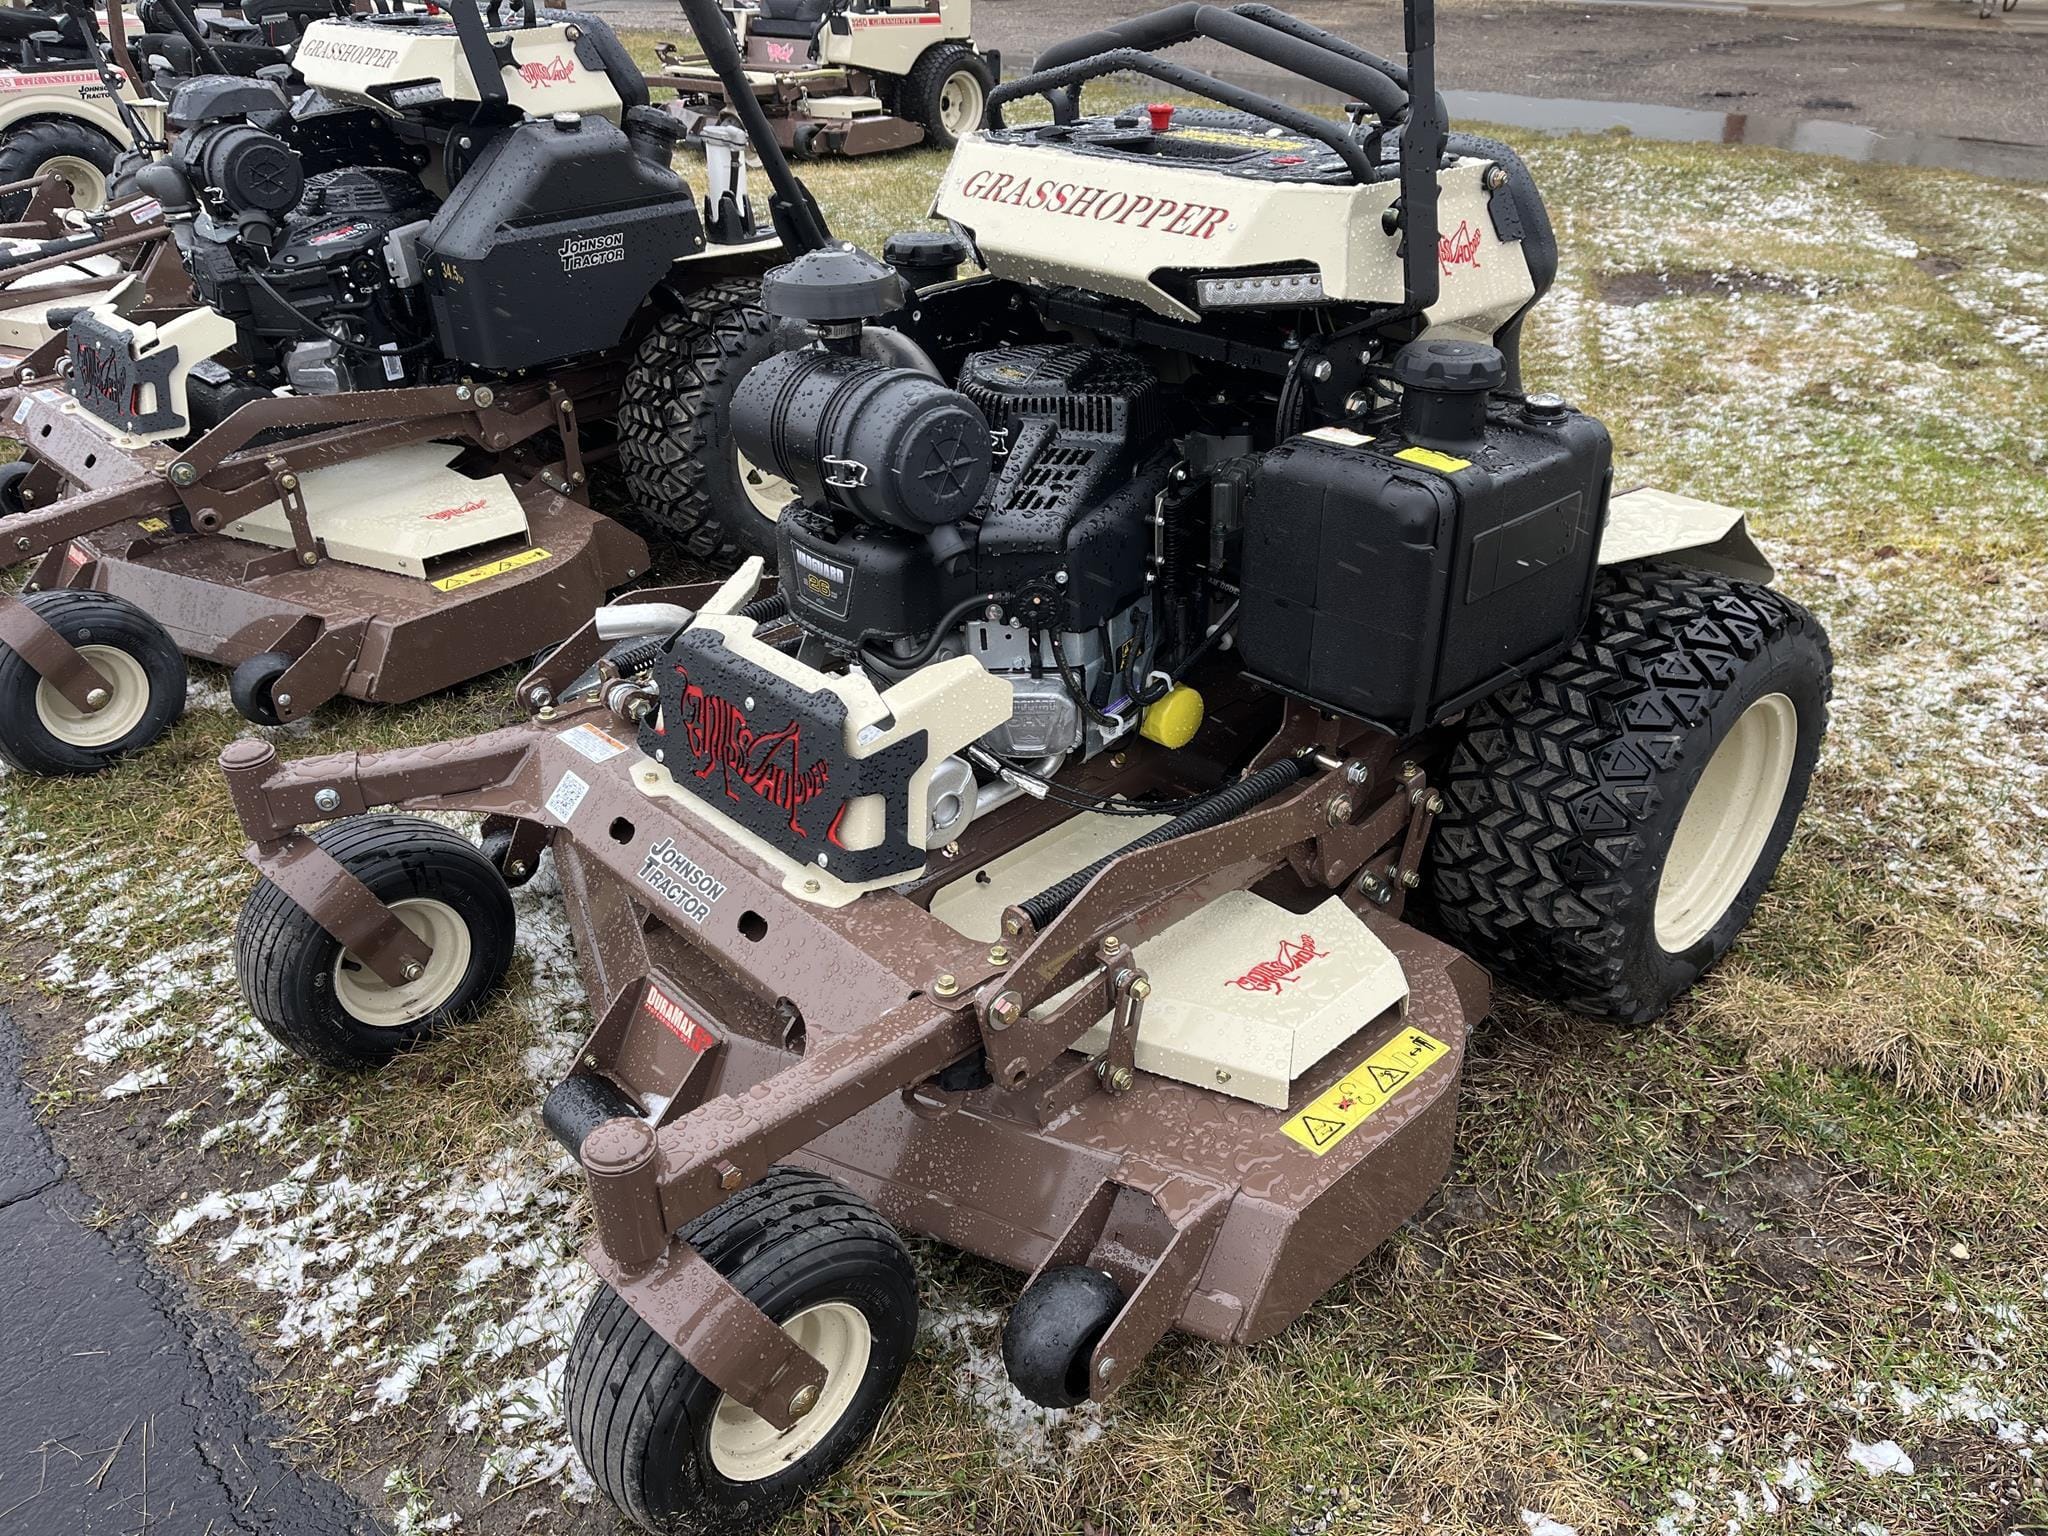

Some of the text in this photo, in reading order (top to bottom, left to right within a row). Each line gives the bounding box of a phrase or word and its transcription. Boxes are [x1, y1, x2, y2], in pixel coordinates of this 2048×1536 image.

[303, 39, 398, 69] GRASSHOPPER
[22, 73, 101, 87] GRASSHOPP
[78, 85, 109, 93] JOHNSO
[80, 91, 110, 100] TRACTO
[963, 170, 1229, 240] GRASSHOPPER
[558, 233, 624, 256] JOHNSON
[561, 248, 625, 271] TRACTOR
[796, 548, 844, 585] VANGUARD
[808, 573, 831, 597] 26
[650, 837, 727, 902] JOHNSON
[637, 855, 711, 924] TRACTOR
